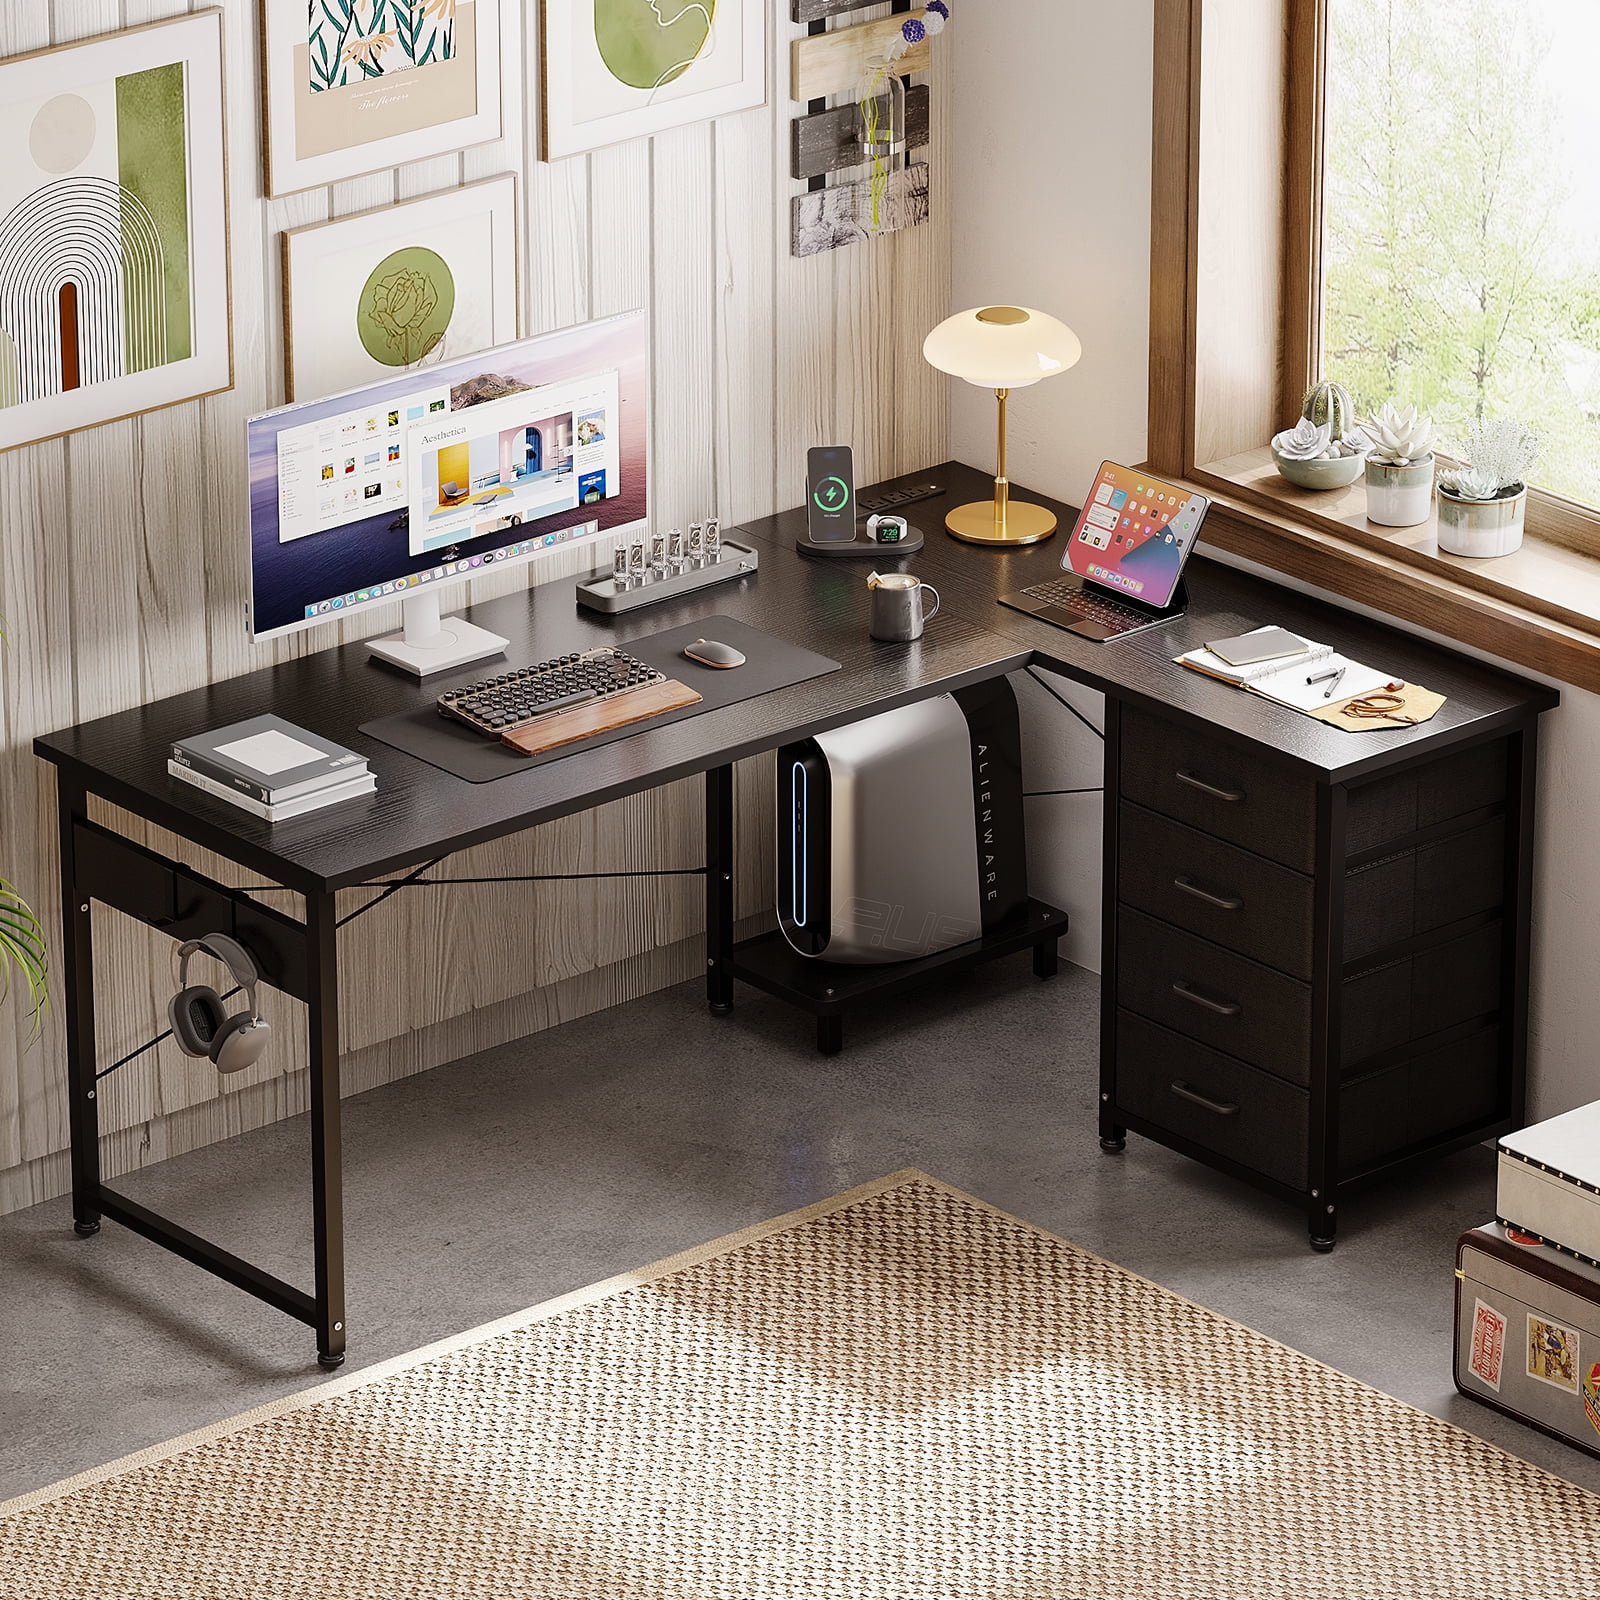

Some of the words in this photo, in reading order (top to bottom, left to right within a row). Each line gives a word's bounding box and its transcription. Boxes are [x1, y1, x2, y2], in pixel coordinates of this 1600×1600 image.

[421, 427, 467, 444] Aesthetica
[882, 528, 898, 536] 7:29
[977, 744, 998, 901] ALIENWARE
[1483, 1322, 1495, 1354] GRAND
[1480, 1351, 1492, 1378] HOTEL
